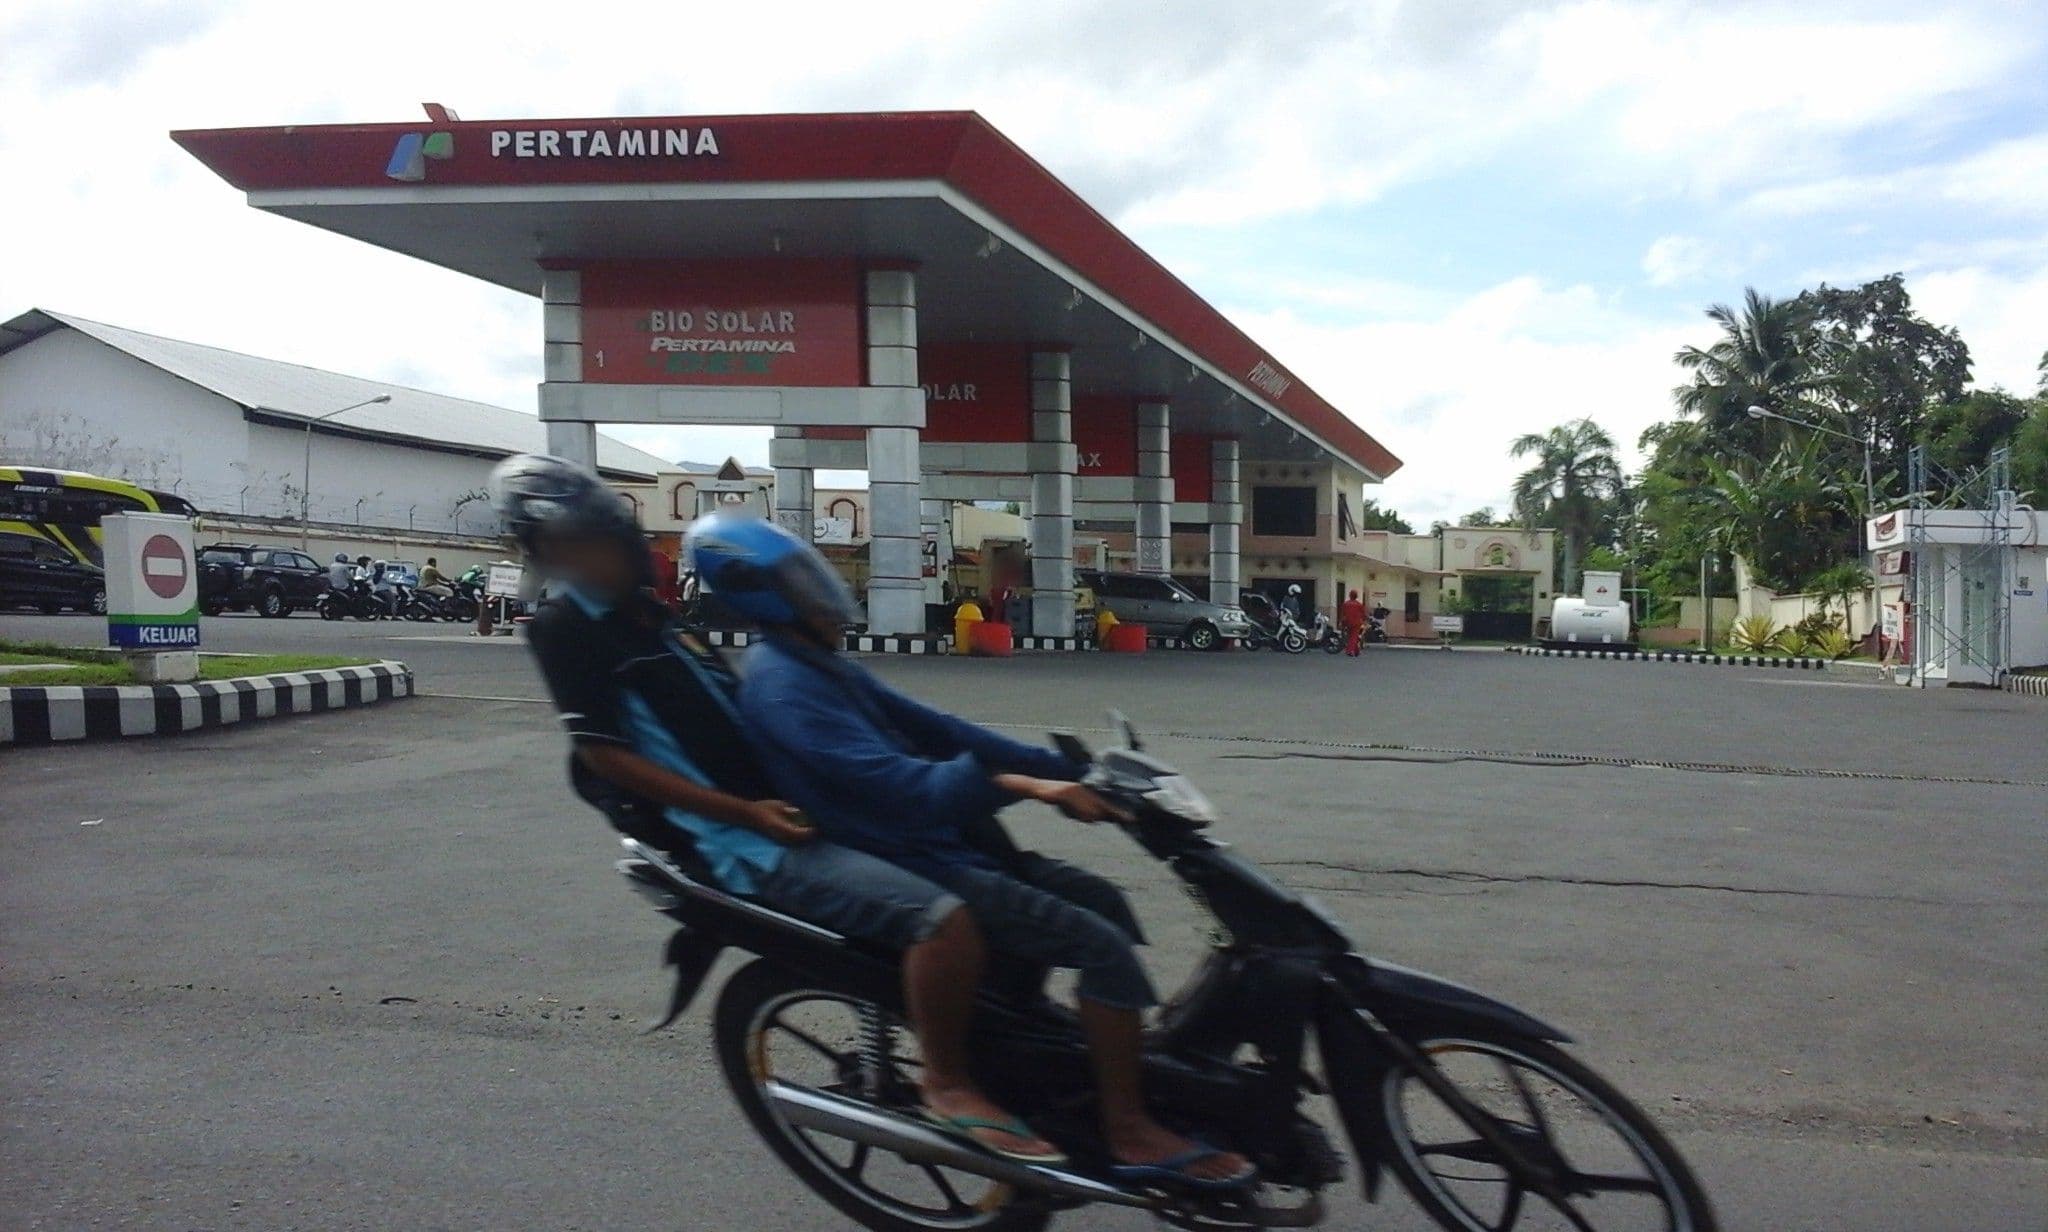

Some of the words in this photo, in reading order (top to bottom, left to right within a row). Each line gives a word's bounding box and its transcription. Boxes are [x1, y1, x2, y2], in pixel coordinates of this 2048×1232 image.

[491, 128, 719, 157] PERTAMINA
[651, 311, 693, 332] BIO
[704, 311, 795, 333] SOLAR
[651, 337, 796, 352] PERTAMINA
[595, 350, 604, 367] 1
[139, 626, 197, 643] KELUAR
